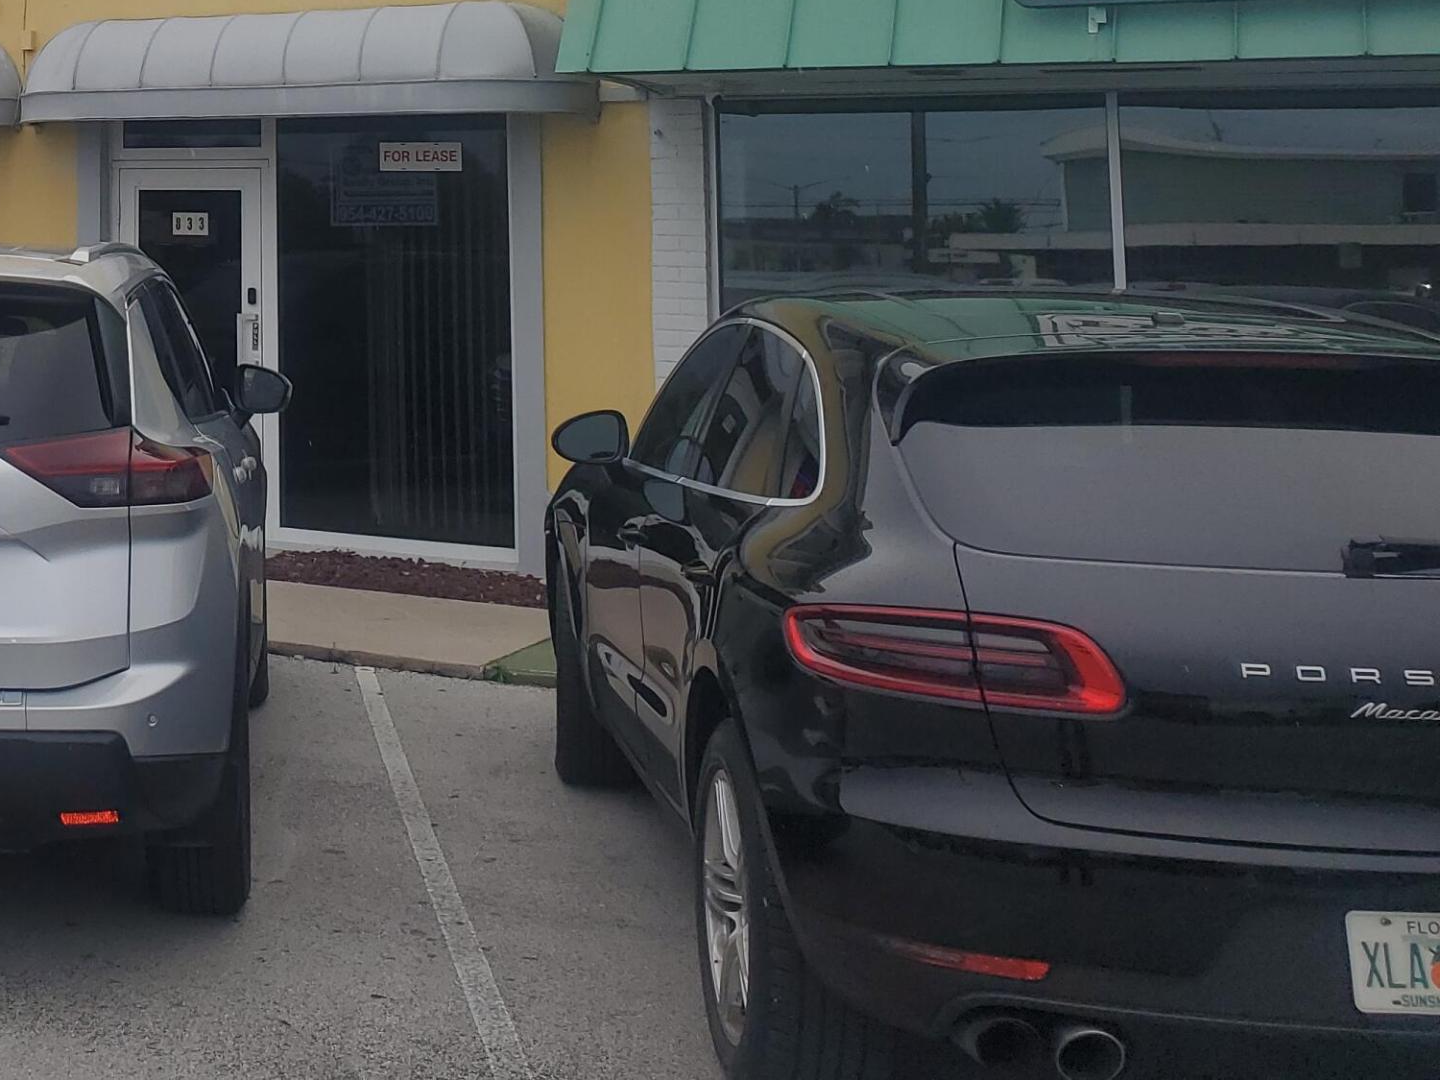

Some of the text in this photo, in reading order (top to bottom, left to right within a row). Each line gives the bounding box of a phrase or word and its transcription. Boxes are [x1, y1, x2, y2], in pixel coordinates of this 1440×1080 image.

[383, 150, 457, 162] FOR LEASE
[175, 216, 205, 231] 833
[1240, 662, 1435, 686] PORS
[1350, 702, 1440, 721] Maca
[1406, 920, 1440, 935] FLO
[1361, 940, 1430, 990] XLA
